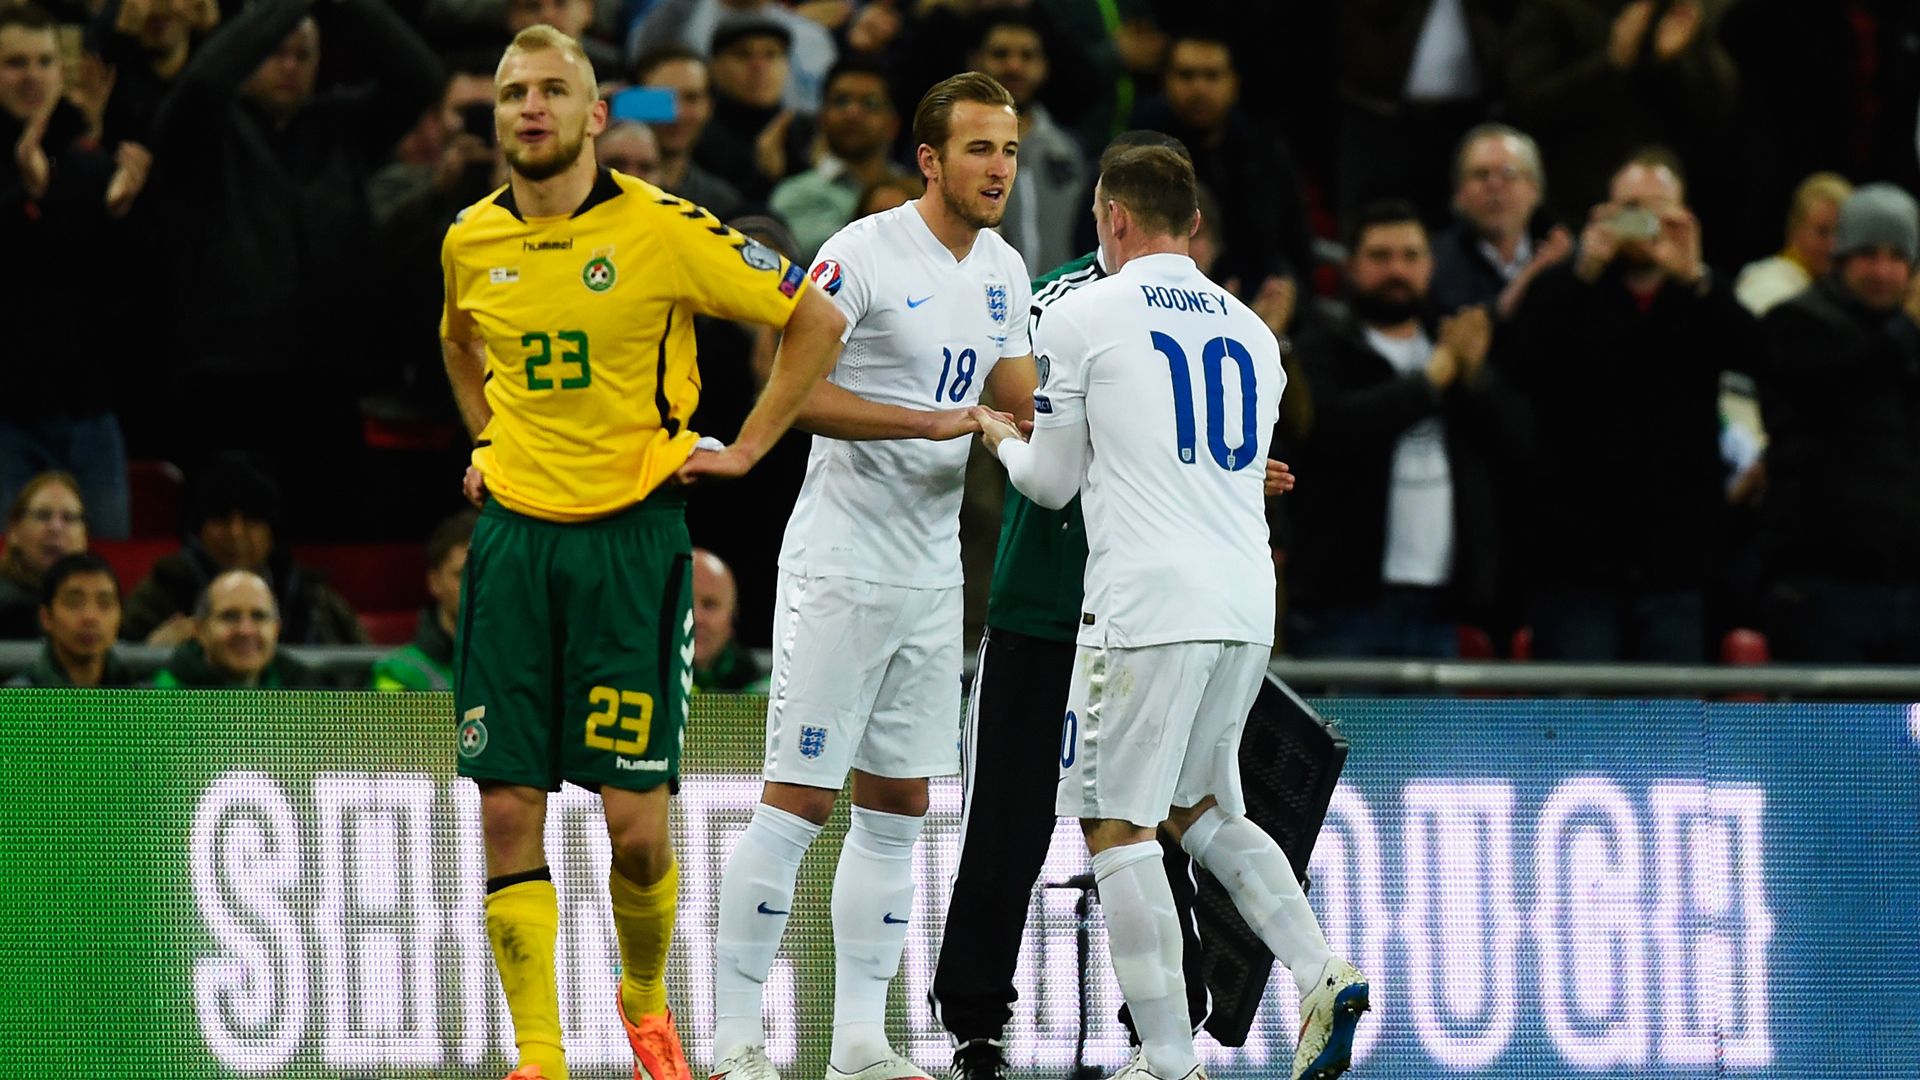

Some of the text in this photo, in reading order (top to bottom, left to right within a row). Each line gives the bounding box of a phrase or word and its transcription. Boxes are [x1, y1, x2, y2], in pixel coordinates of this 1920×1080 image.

[524, 238, 573, 251] hummel
[1141, 285, 1228, 315] ROONEY
[523, 331, 591, 390] 23
[936, 348, 976, 402] 18
[1151, 331, 1258, 471] 10
[586, 687, 653, 753] 23
[1060, 711, 1077, 768] 0
[616, 756, 669, 771] hummel
